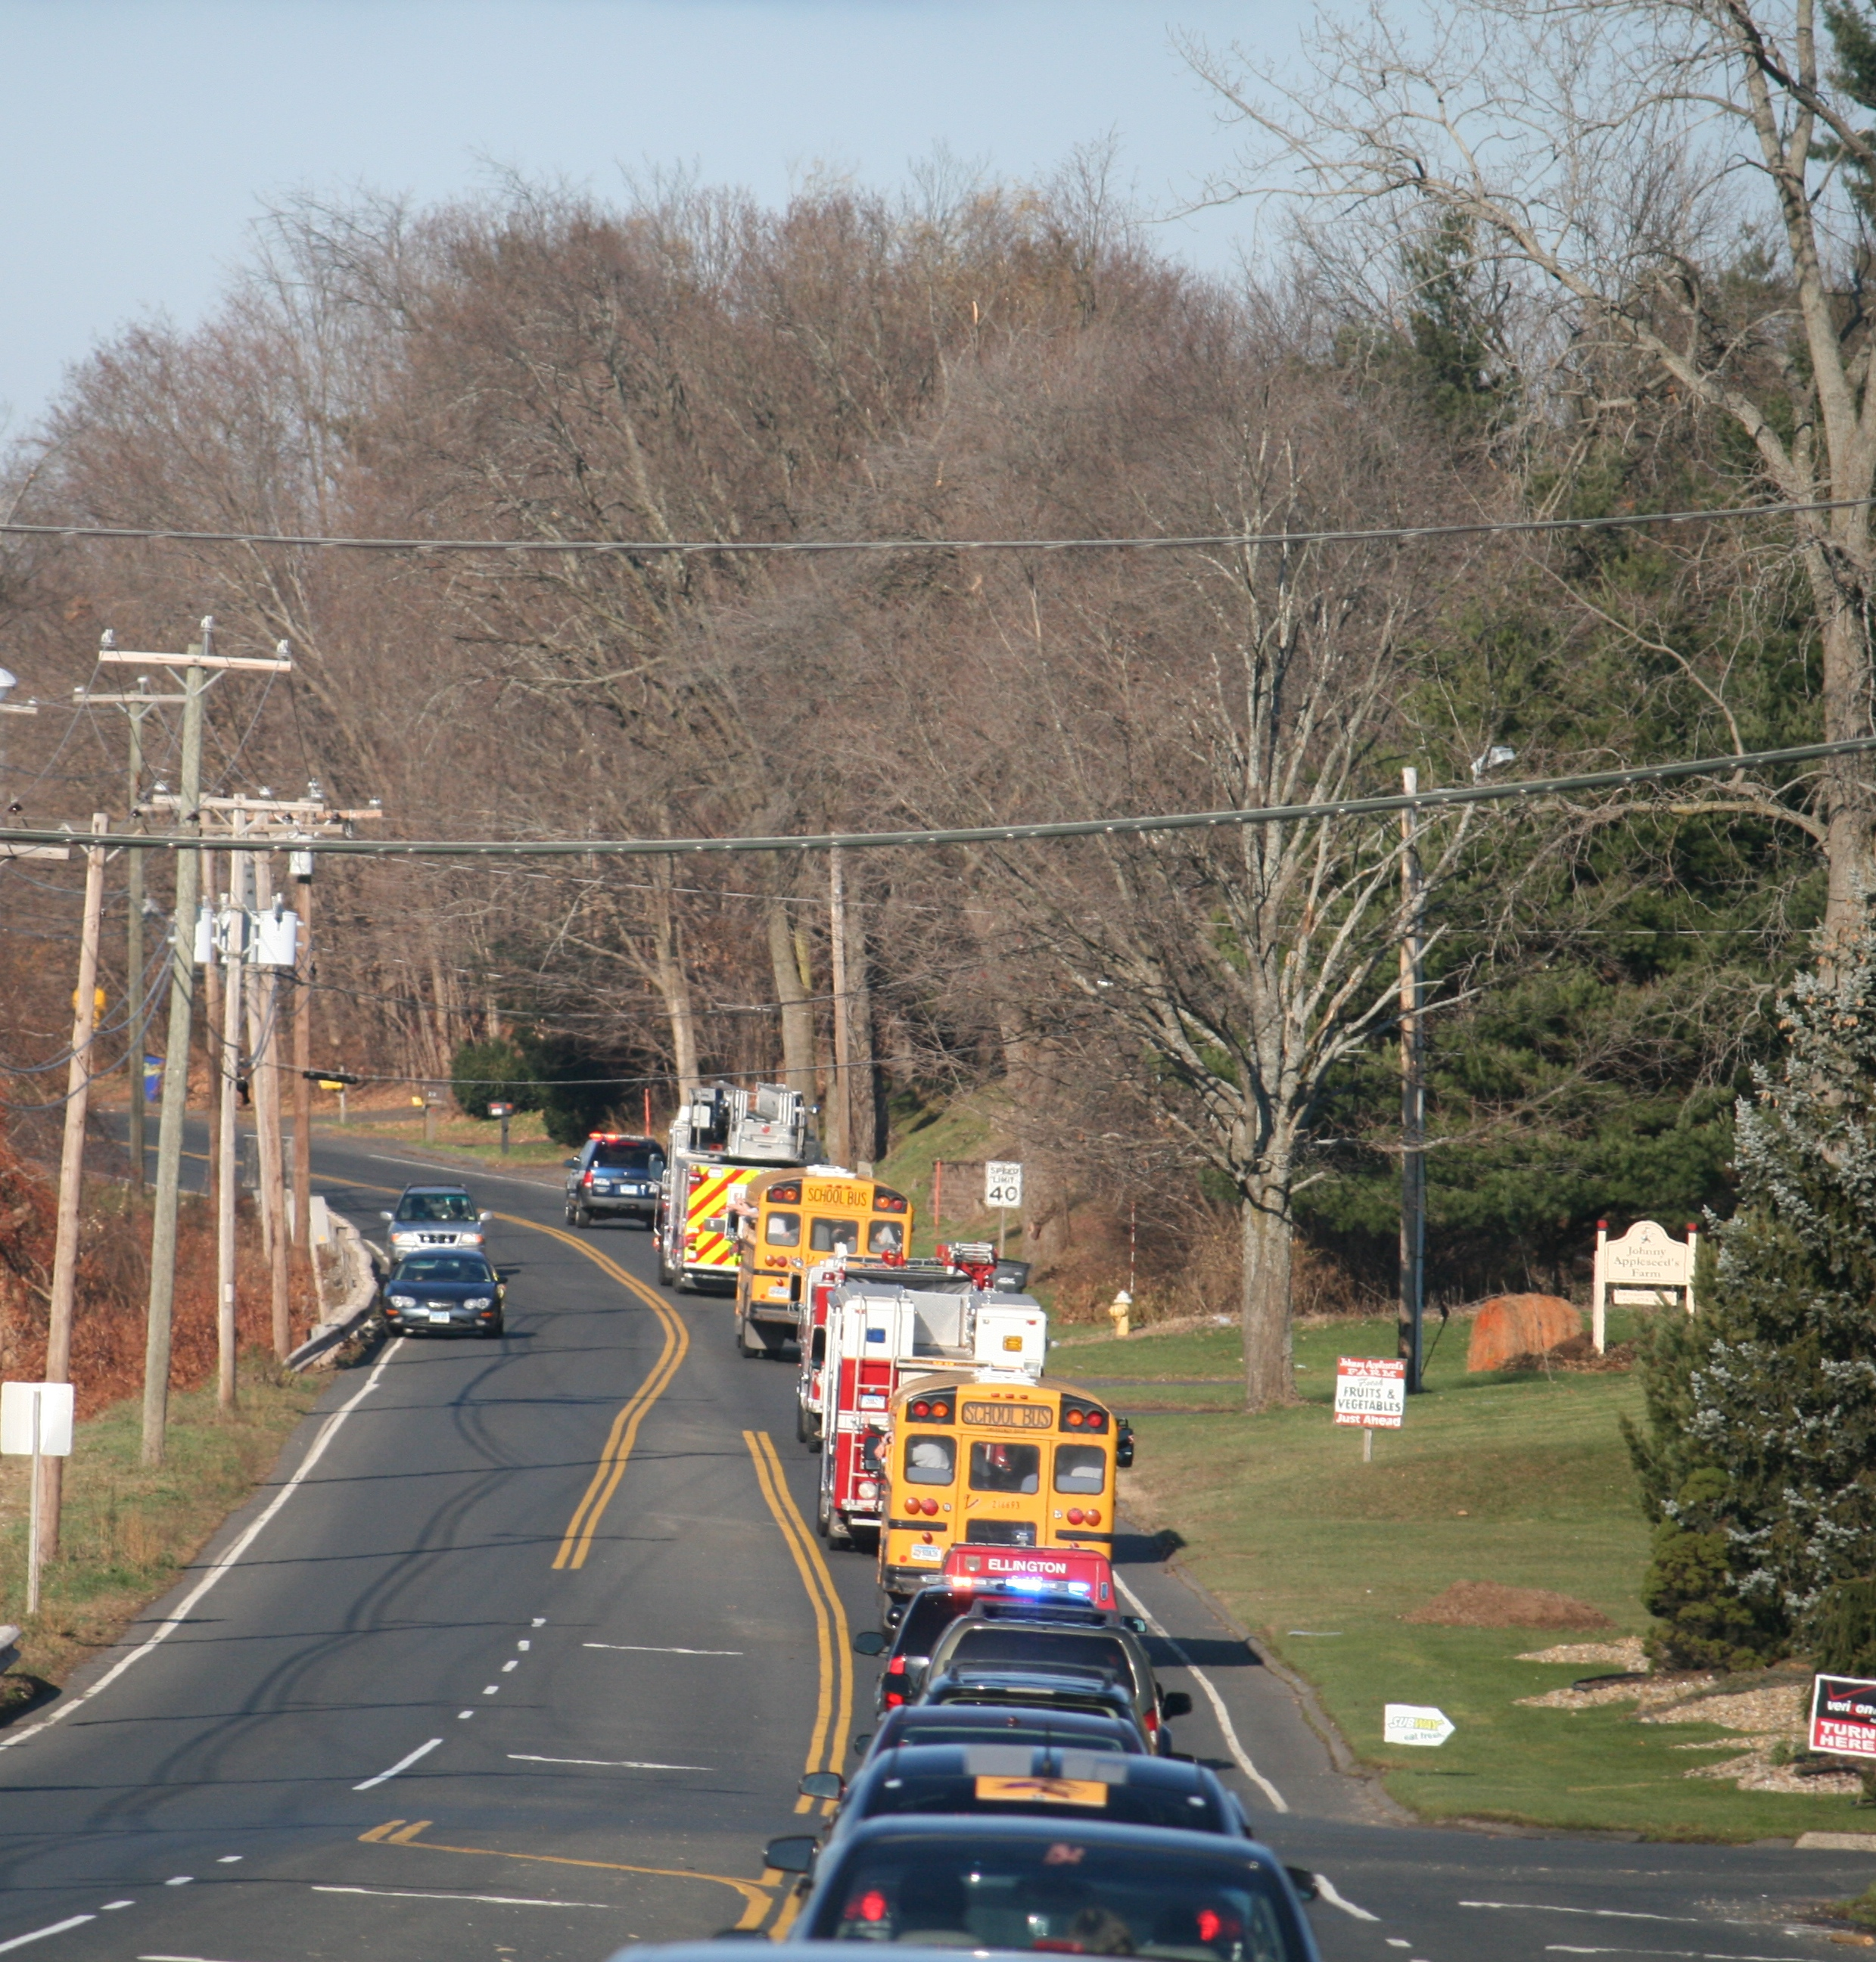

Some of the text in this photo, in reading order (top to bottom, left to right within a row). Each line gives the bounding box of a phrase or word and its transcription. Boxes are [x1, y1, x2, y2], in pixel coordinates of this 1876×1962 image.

[990, 1166, 1019, 1175] SPEED
[807, 1188, 867, 1207] SCHOOL BUS
[989, 1185, 1018, 1202] 40
[1626, 1246, 1666, 1257] Johnny
[1613, 1257, 1680, 1267] Appleseed's
[1632, 1269, 1661, 1278] Farm
[1347, 1368, 1396, 1377] FARM
[1343, 1386, 1395, 1400] FRUITS &
[1337, 1398, 1401, 1412] VEGETABLES
[966, 1406, 1050, 1427] SCHOOL BUS
[1336, 1414, 1401, 1427] Just Ahead
[988, 1558, 1067, 1574] ELLINGTON
[1387, 1716, 1444, 1731] SUBWAY
[1820, 1721, 1876, 1739] TURN
[1819, 1733, 1875, 1752] HERE
